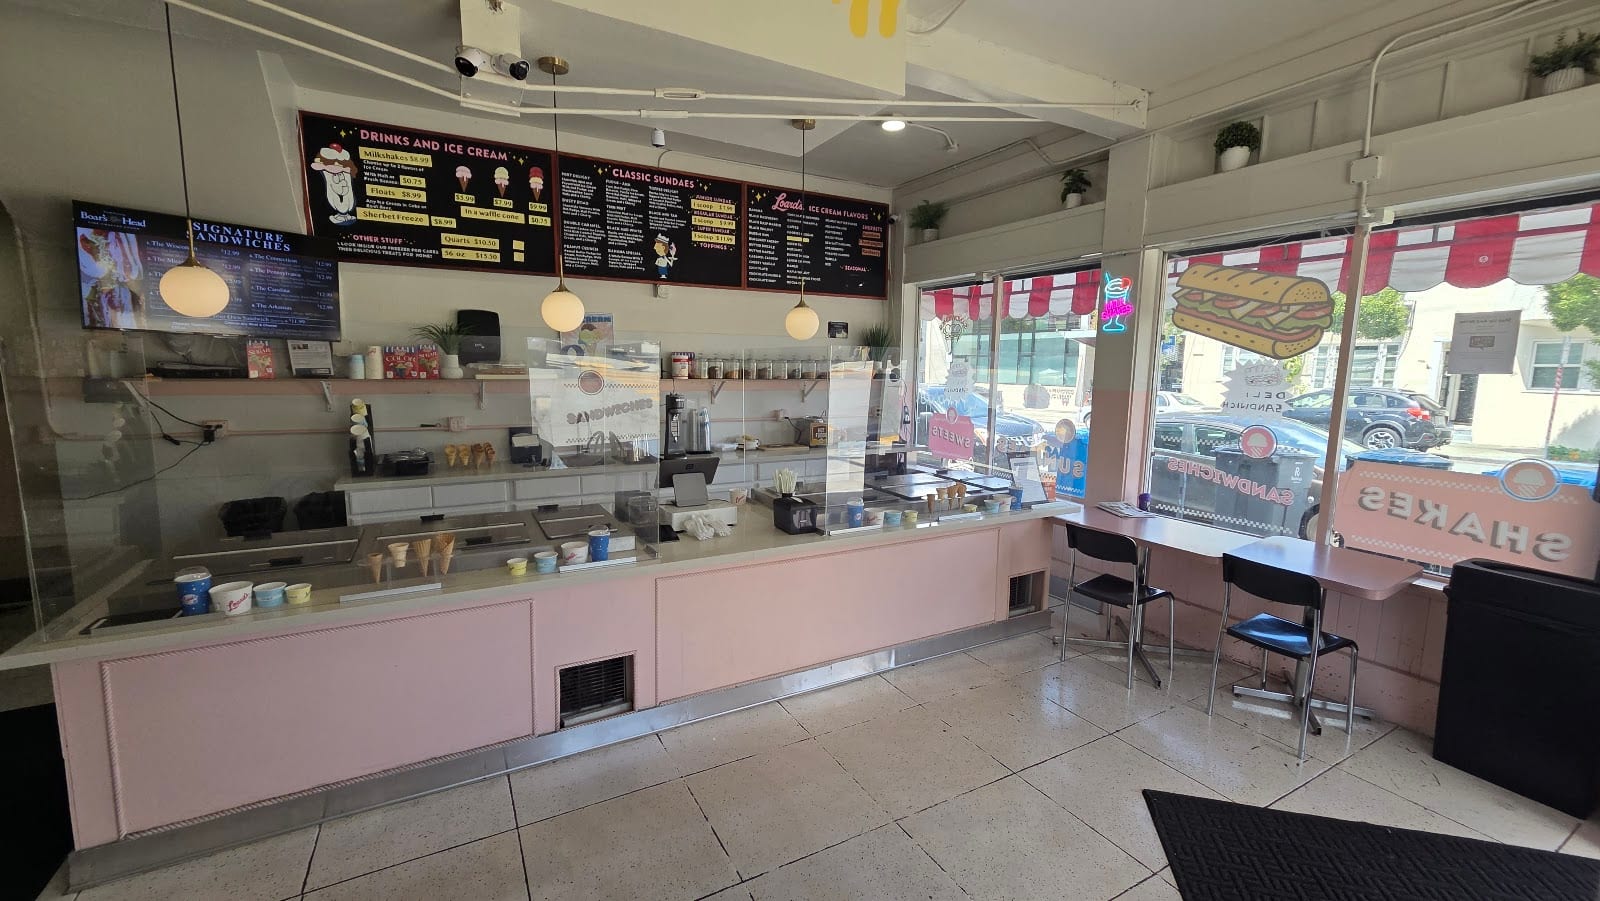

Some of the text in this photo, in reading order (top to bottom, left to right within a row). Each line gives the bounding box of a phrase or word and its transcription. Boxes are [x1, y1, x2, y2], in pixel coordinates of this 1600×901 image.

[360, 130, 508, 161] DRINKS AND ICE CREAM
[364, 150, 409, 161] Milkshakes
[612, 168, 695, 189] CLASSIC SUNDAES
[371, 188, 396, 196] Floats
[80, 210, 108, 222] Boar's
[122, 217, 146, 228] Head
[362, 211, 396, 220] Sherbet
[397, 215, 424, 223] Freeze
[480, 209, 500, 218] waffle
[808, 206, 820, 214] ICE
[820, 208, 842, 216] CREAM
[844, 210, 869, 220] FLAVORS
[193, 221, 284, 243] SIGNATURE
[353, 234, 403, 245] OTHER STUFF
[444, 236, 470, 244] Quarts
[566, 398, 653, 425] SANDWICHES
